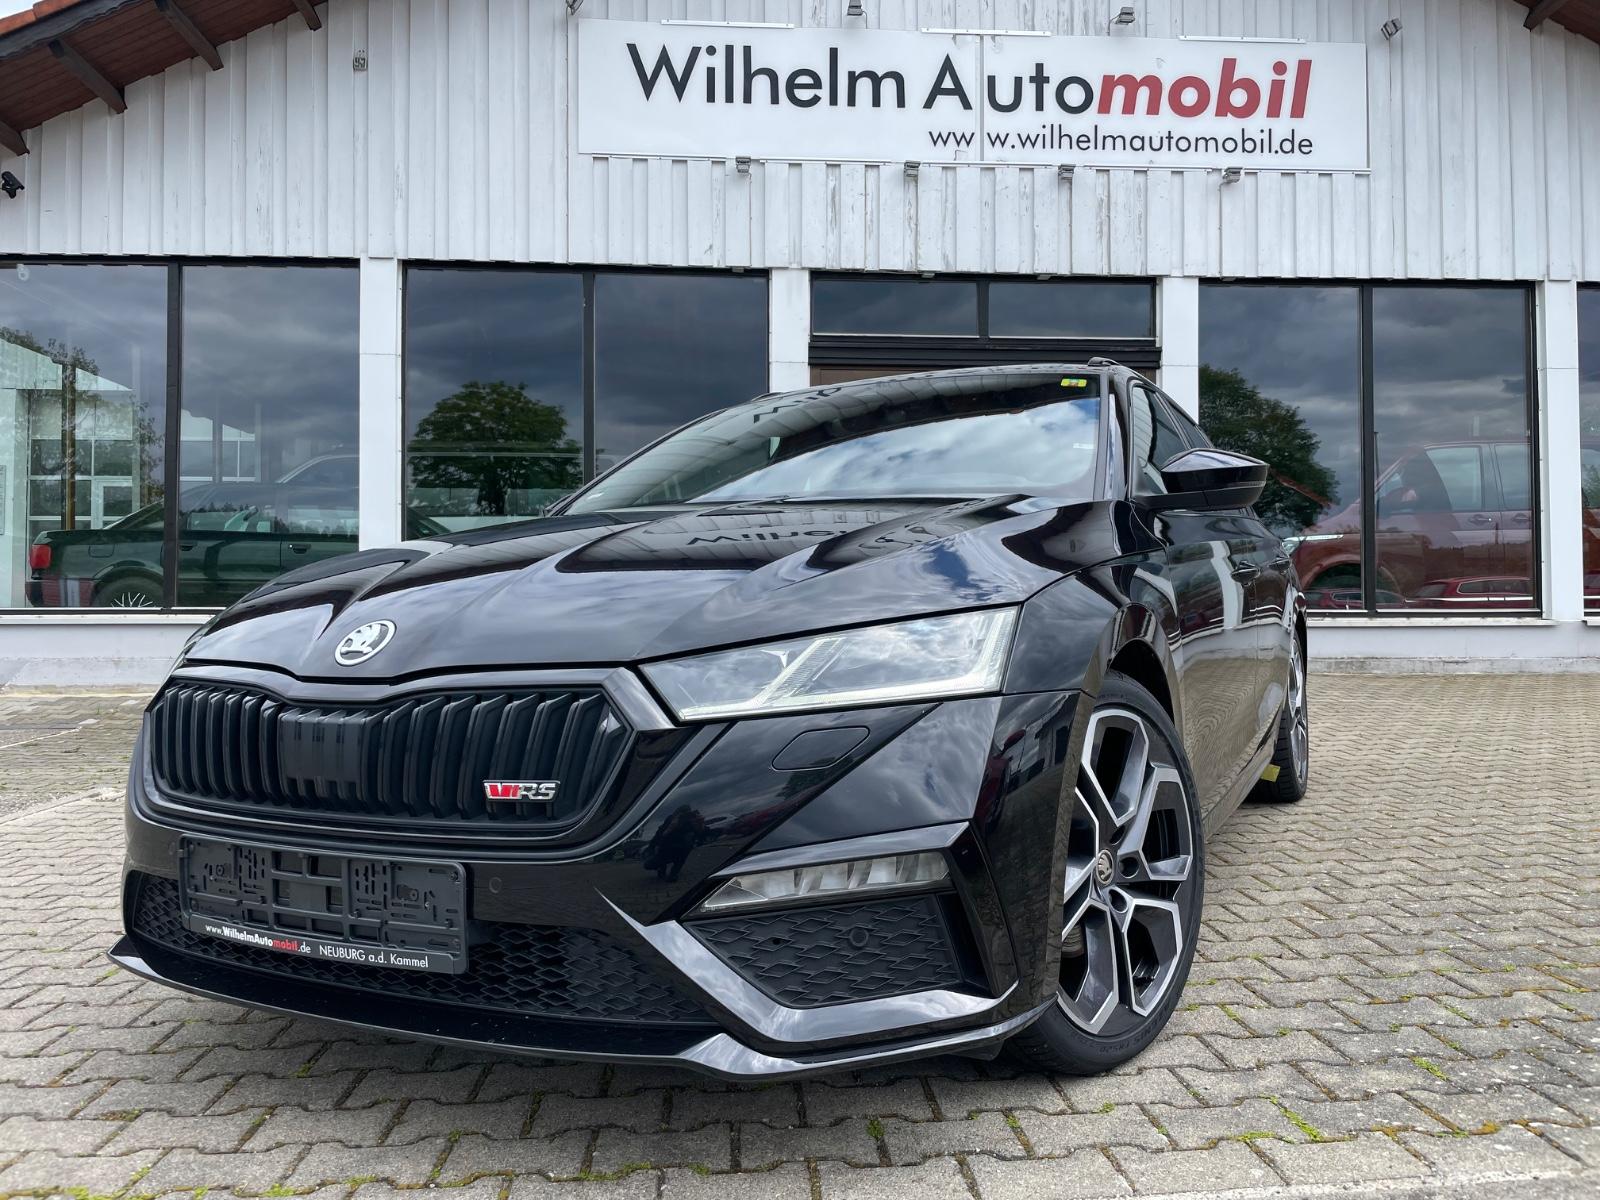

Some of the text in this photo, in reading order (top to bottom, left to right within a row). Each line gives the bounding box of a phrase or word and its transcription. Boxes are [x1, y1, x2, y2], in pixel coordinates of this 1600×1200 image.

[626, 42, 1313, 119] Wilhelm Automobil
[928, 124, 1313, 155] www.wilhelmautomobil.de
[205, 924, 429, 968] www.WilhelmAutomobil.de NEUBURG a.d. Kammel
